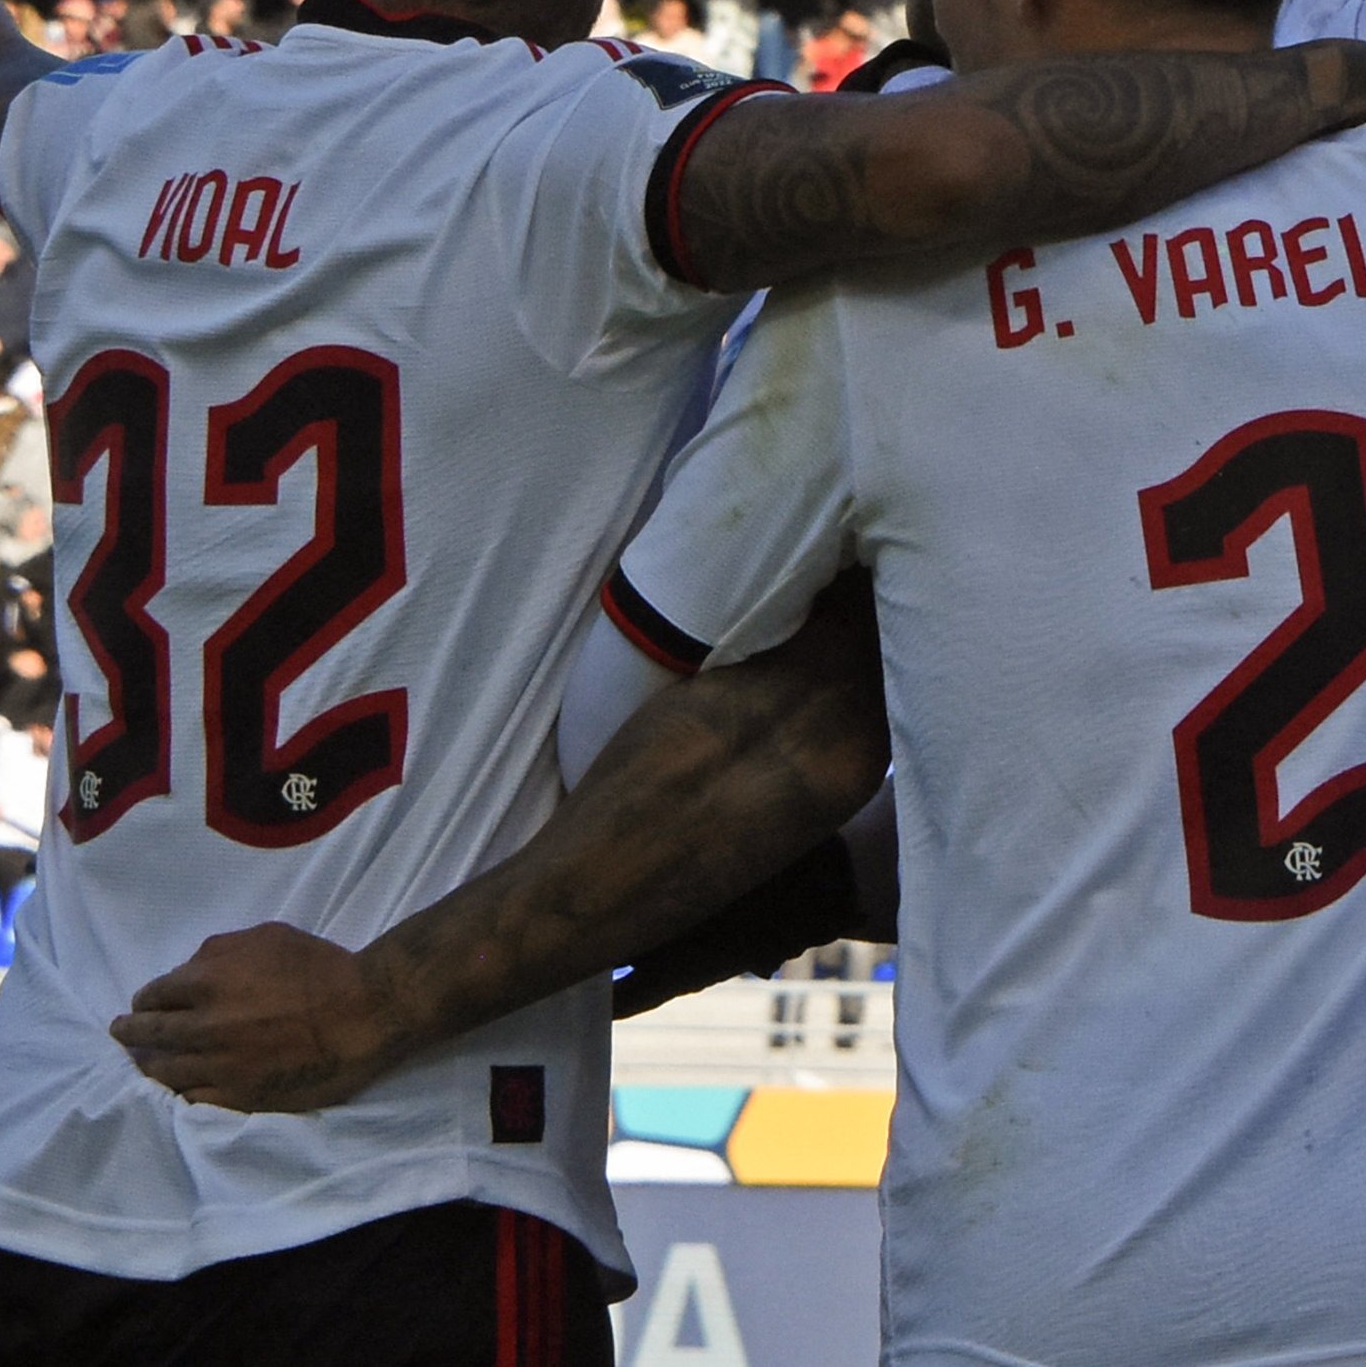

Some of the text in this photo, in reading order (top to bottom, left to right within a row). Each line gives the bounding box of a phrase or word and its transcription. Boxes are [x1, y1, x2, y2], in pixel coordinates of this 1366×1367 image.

[138, 169, 302, 269] VIDAL
[985, 246, 1075, 350] G.
[47, 344, 408, 849] 32
